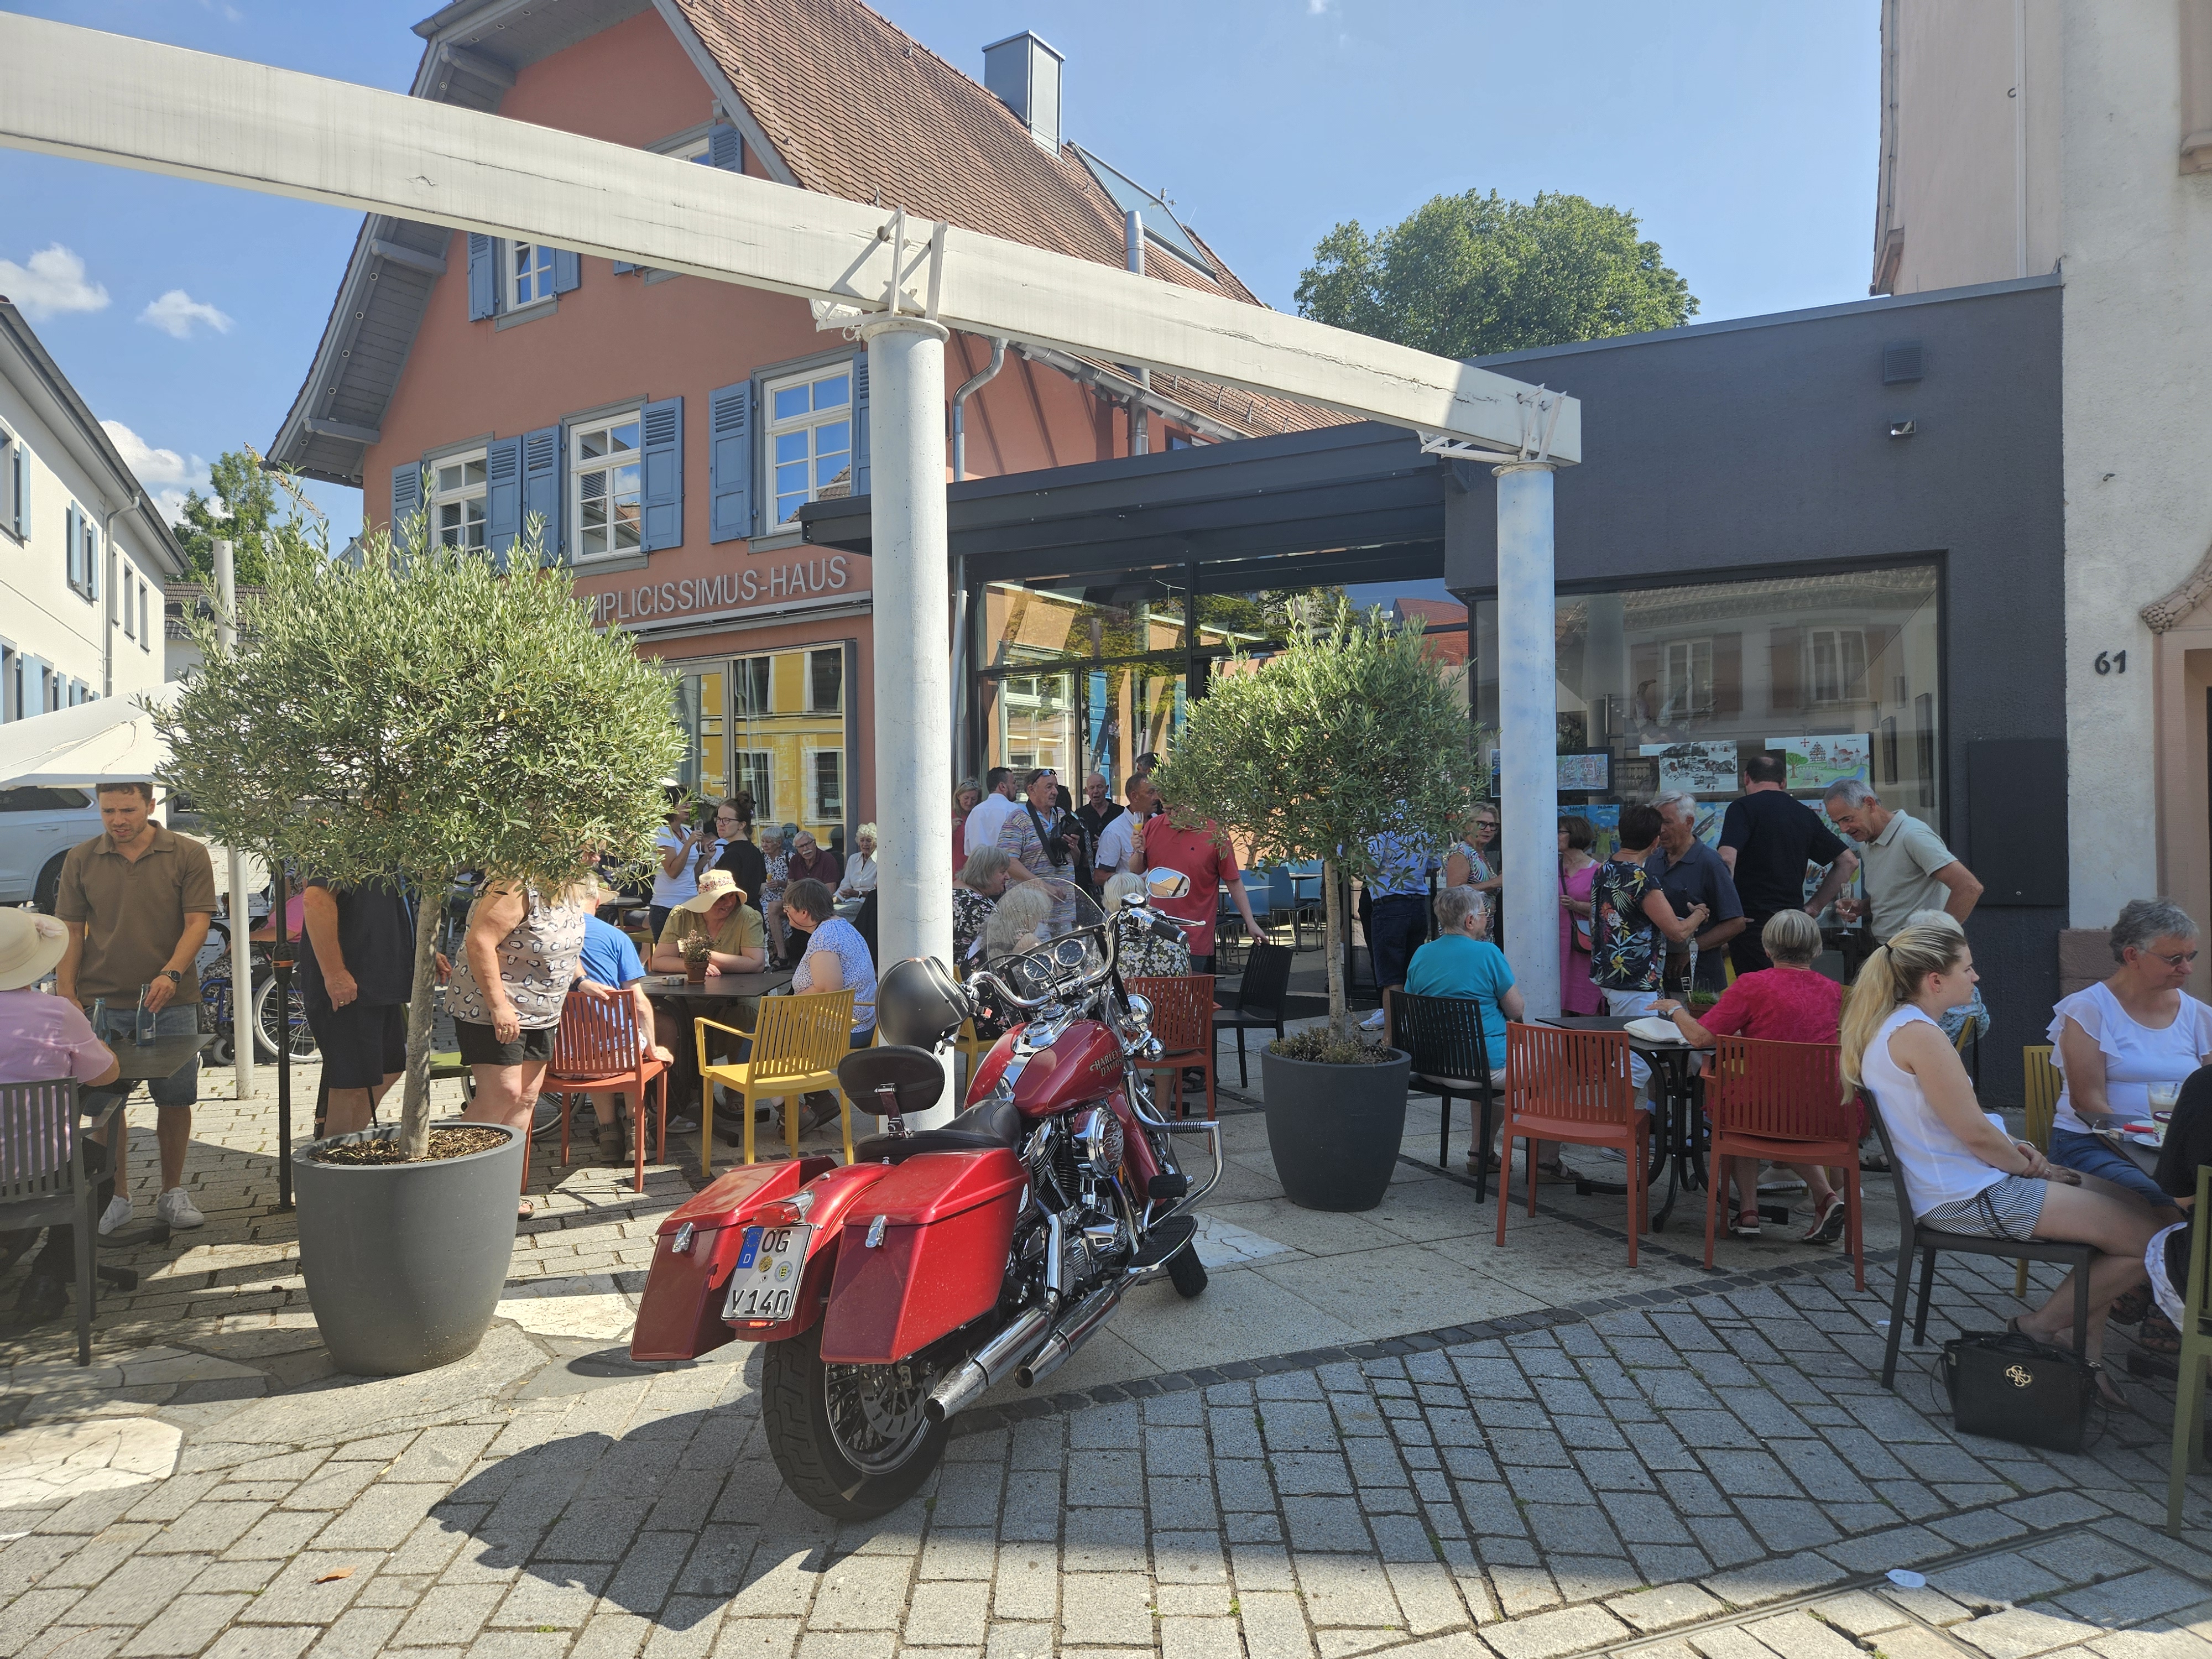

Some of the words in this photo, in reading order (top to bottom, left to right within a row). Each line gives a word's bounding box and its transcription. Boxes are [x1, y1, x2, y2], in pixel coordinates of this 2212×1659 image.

[564, 555, 847, 624] MPLICISSIMUS-HAUS
[2094, 649, 2127, 675] 61
[1100, 1057, 1123, 1077] DAVIDS
[761, 1230, 791, 1253] OG
[743, 1254, 751, 1264] D
